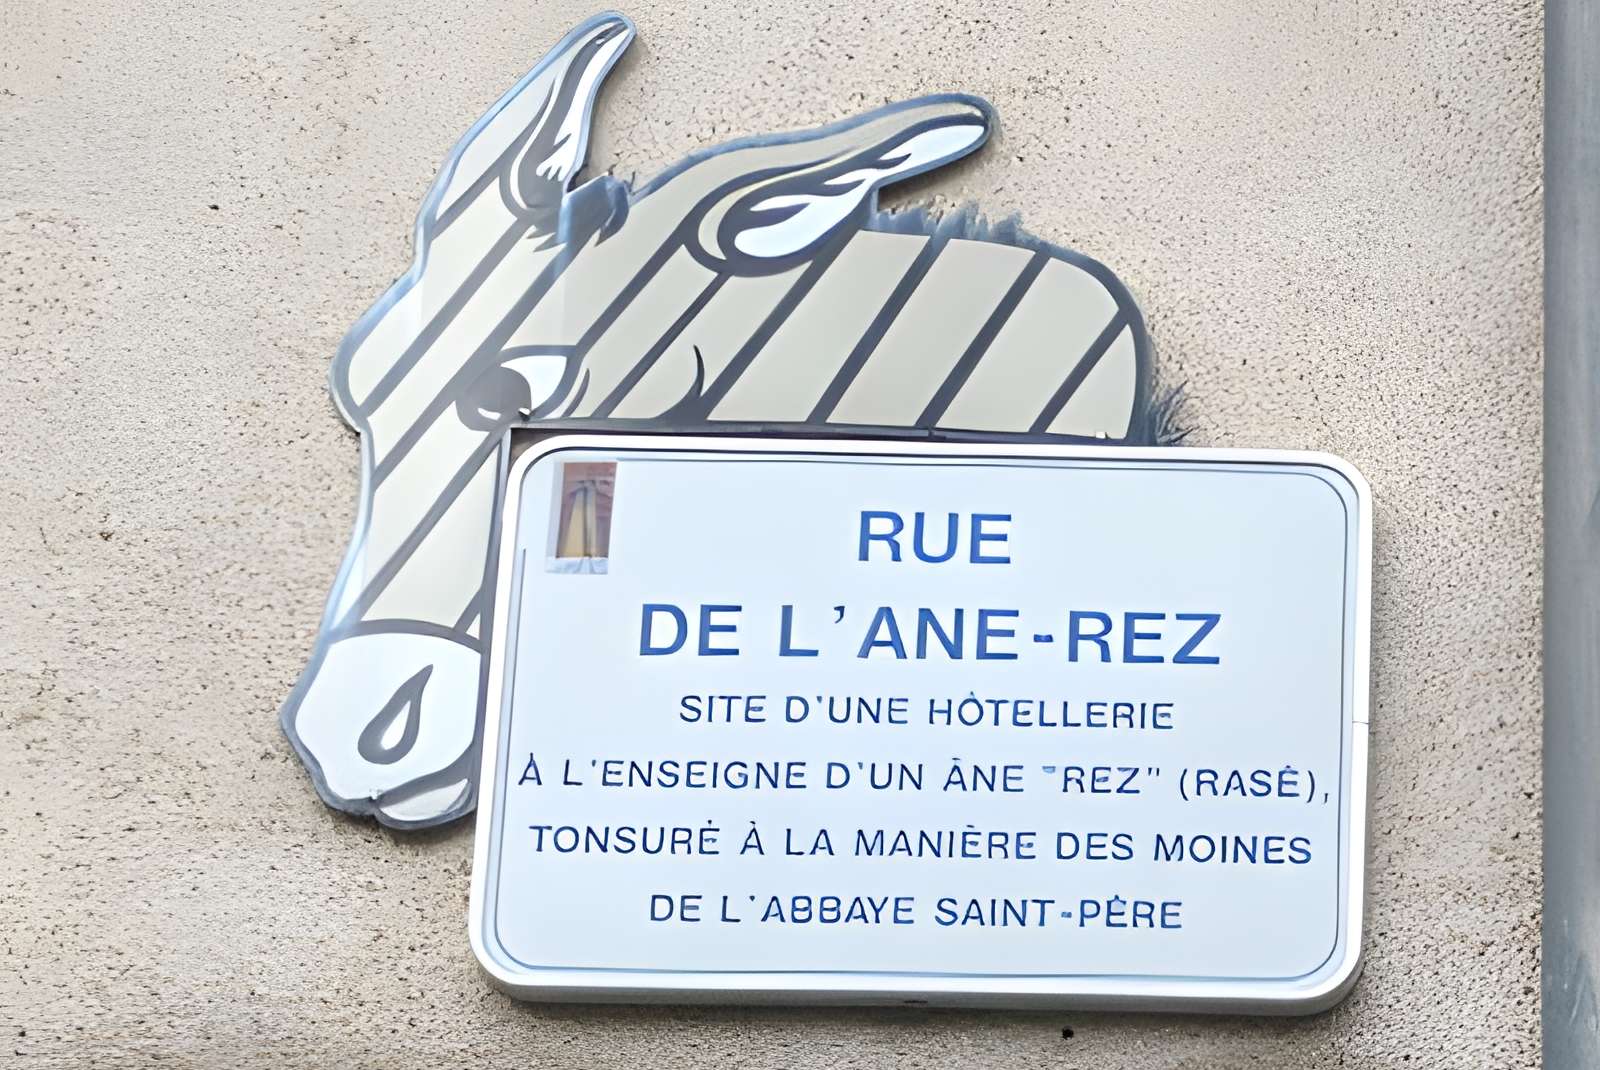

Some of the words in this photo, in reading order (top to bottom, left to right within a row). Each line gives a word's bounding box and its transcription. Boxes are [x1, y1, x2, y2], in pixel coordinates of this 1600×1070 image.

[858, 510, 1013, 565] RUE
[639, 603, 743, 657] DE
[778, 604, 1222, 665] L'ANE-REZ
[679, 694, 767, 724] SITE
[785, 695, 909, 725] D'UNE
[928, 690, 1175, 730] HÔTELLERIE
[517, 751, 543, 786] À
[562, 758, 808, 790] L'ENSEIGNE
[825, 761, 924, 791] D'UN
[528, 819, 721, 856] TONSURÉ
[739, 820, 765, 856] À
[785, 827, 836, 857] LA
[854, 824, 1037, 860] MANIÈRE
[1056, 831, 1134, 861] DES
[1153, 833, 1312, 865] MOINES
[650, 894, 703, 923] DE
[720, 894, 915, 925] L'ABBAYE
